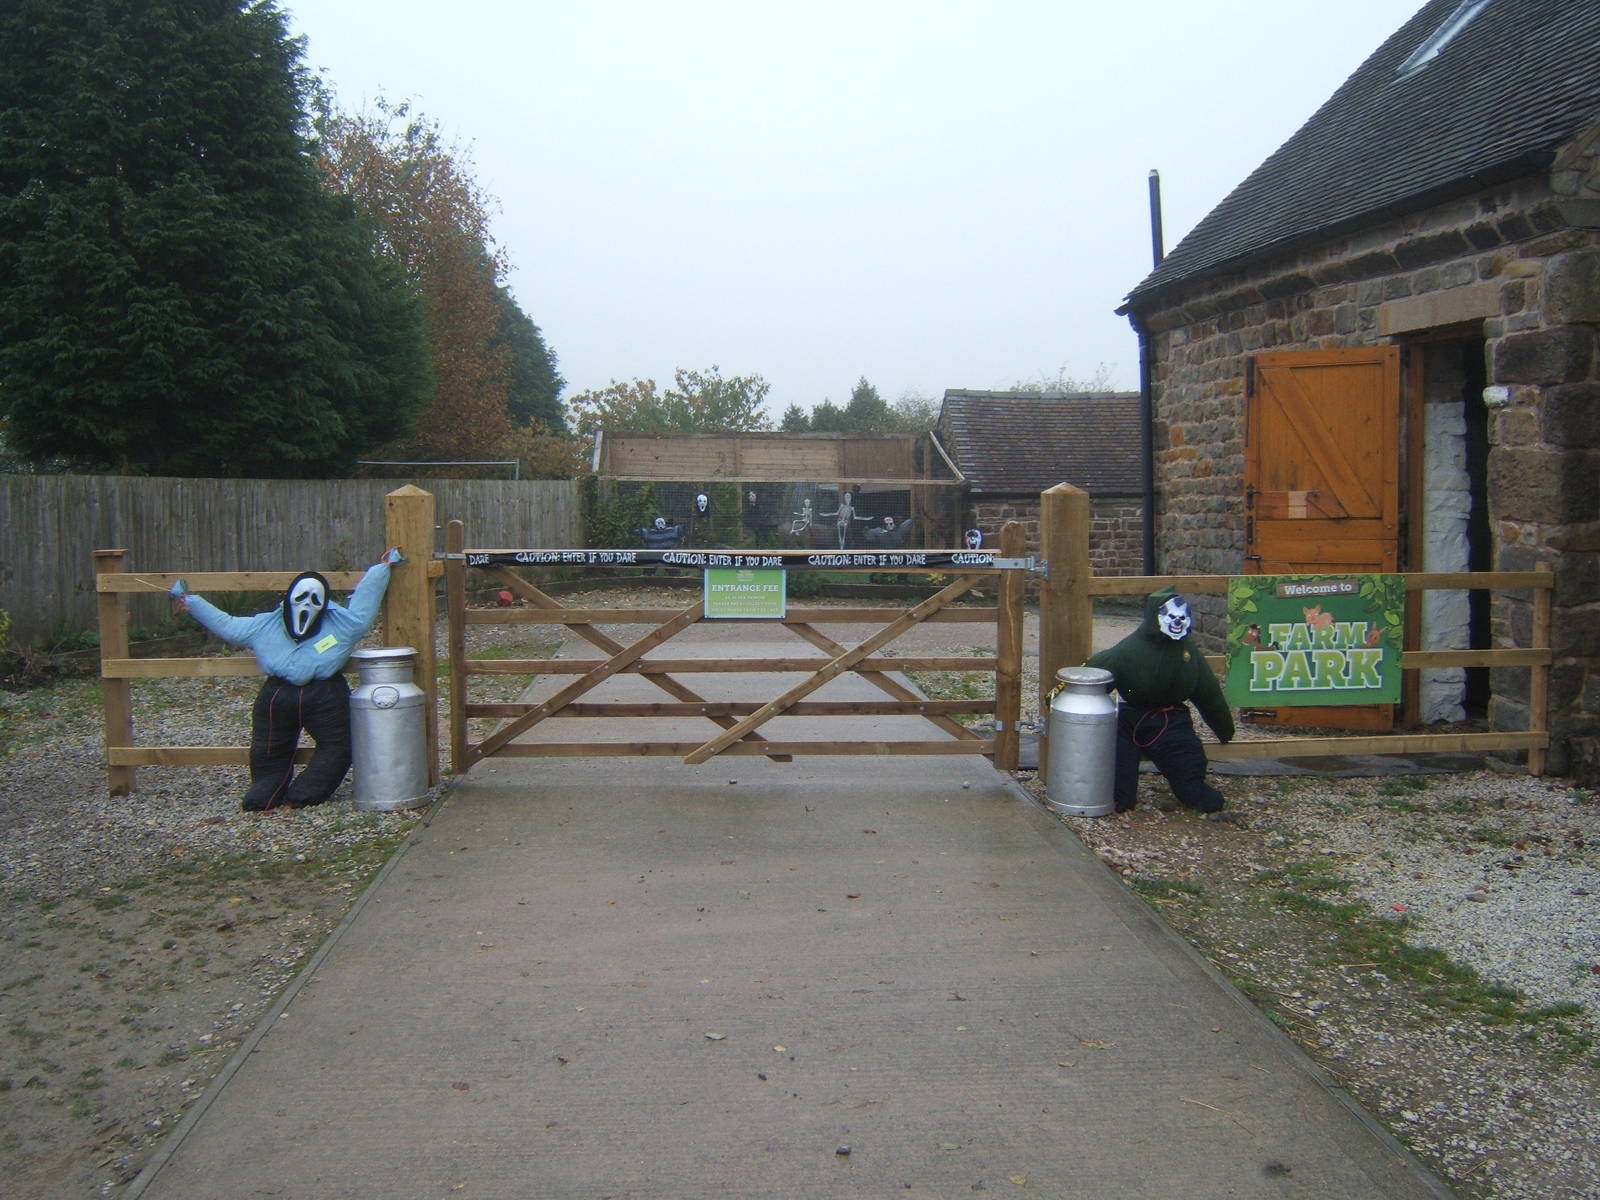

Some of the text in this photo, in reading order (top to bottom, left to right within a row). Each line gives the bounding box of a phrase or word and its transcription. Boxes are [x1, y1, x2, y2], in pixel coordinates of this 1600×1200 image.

[469, 554, 489, 565] DARE
[515, 552, 637, 564] CAUTION: ENTER IF YOU DARE
[662, 552, 783, 567] CAUTION: ENTER IF YOU DARE
[808, 554, 926, 566] CAUTION: ENTER IF YOU DARE
[711, 584, 779, 592] ENTRANCE FEE
[1284, 583, 1353, 596] Welcome to
[1268, 621, 1369, 651] FARM
[1250, 648, 1384, 692] PARK
